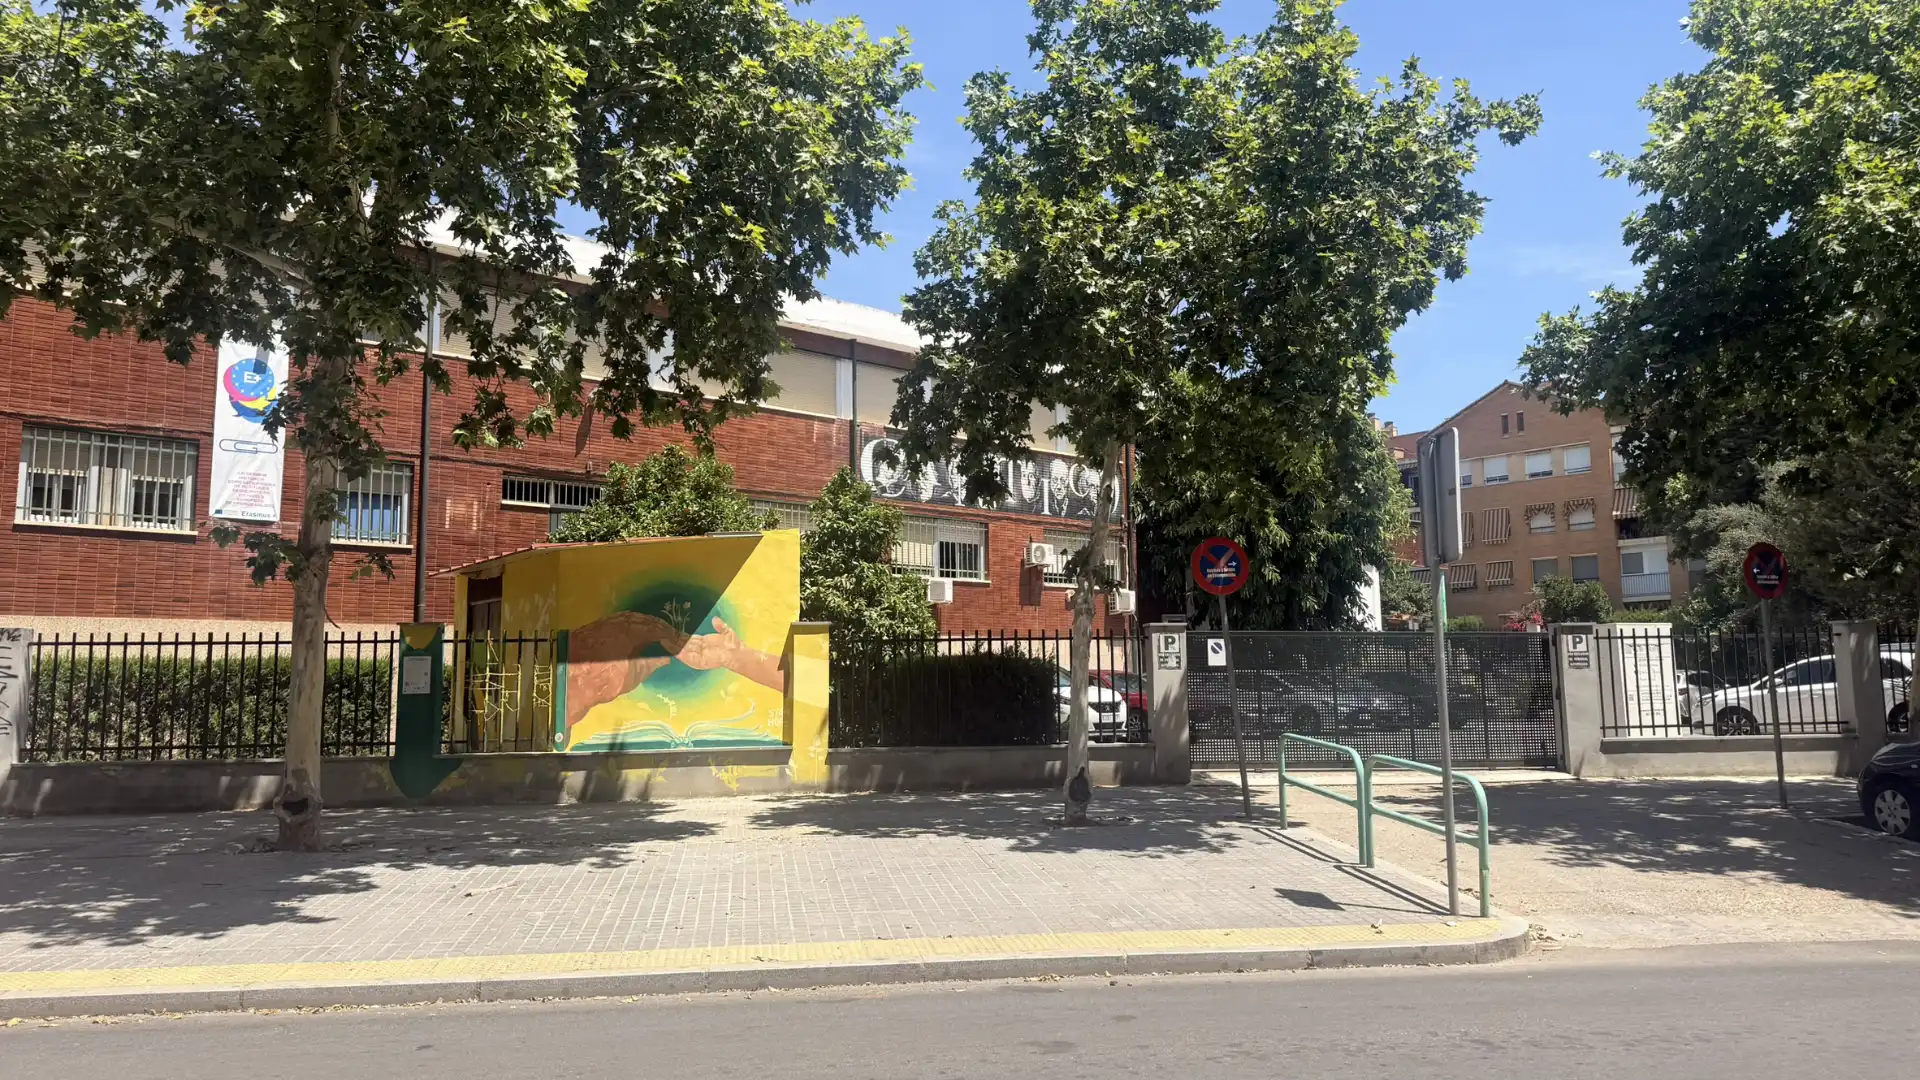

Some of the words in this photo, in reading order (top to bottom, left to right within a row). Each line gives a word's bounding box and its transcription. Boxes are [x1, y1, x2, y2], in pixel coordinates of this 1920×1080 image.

[241, 510, 270, 518] Erasmus
[1164, 635, 1176, 651] P
[1572, 635, 1584, 650] P
